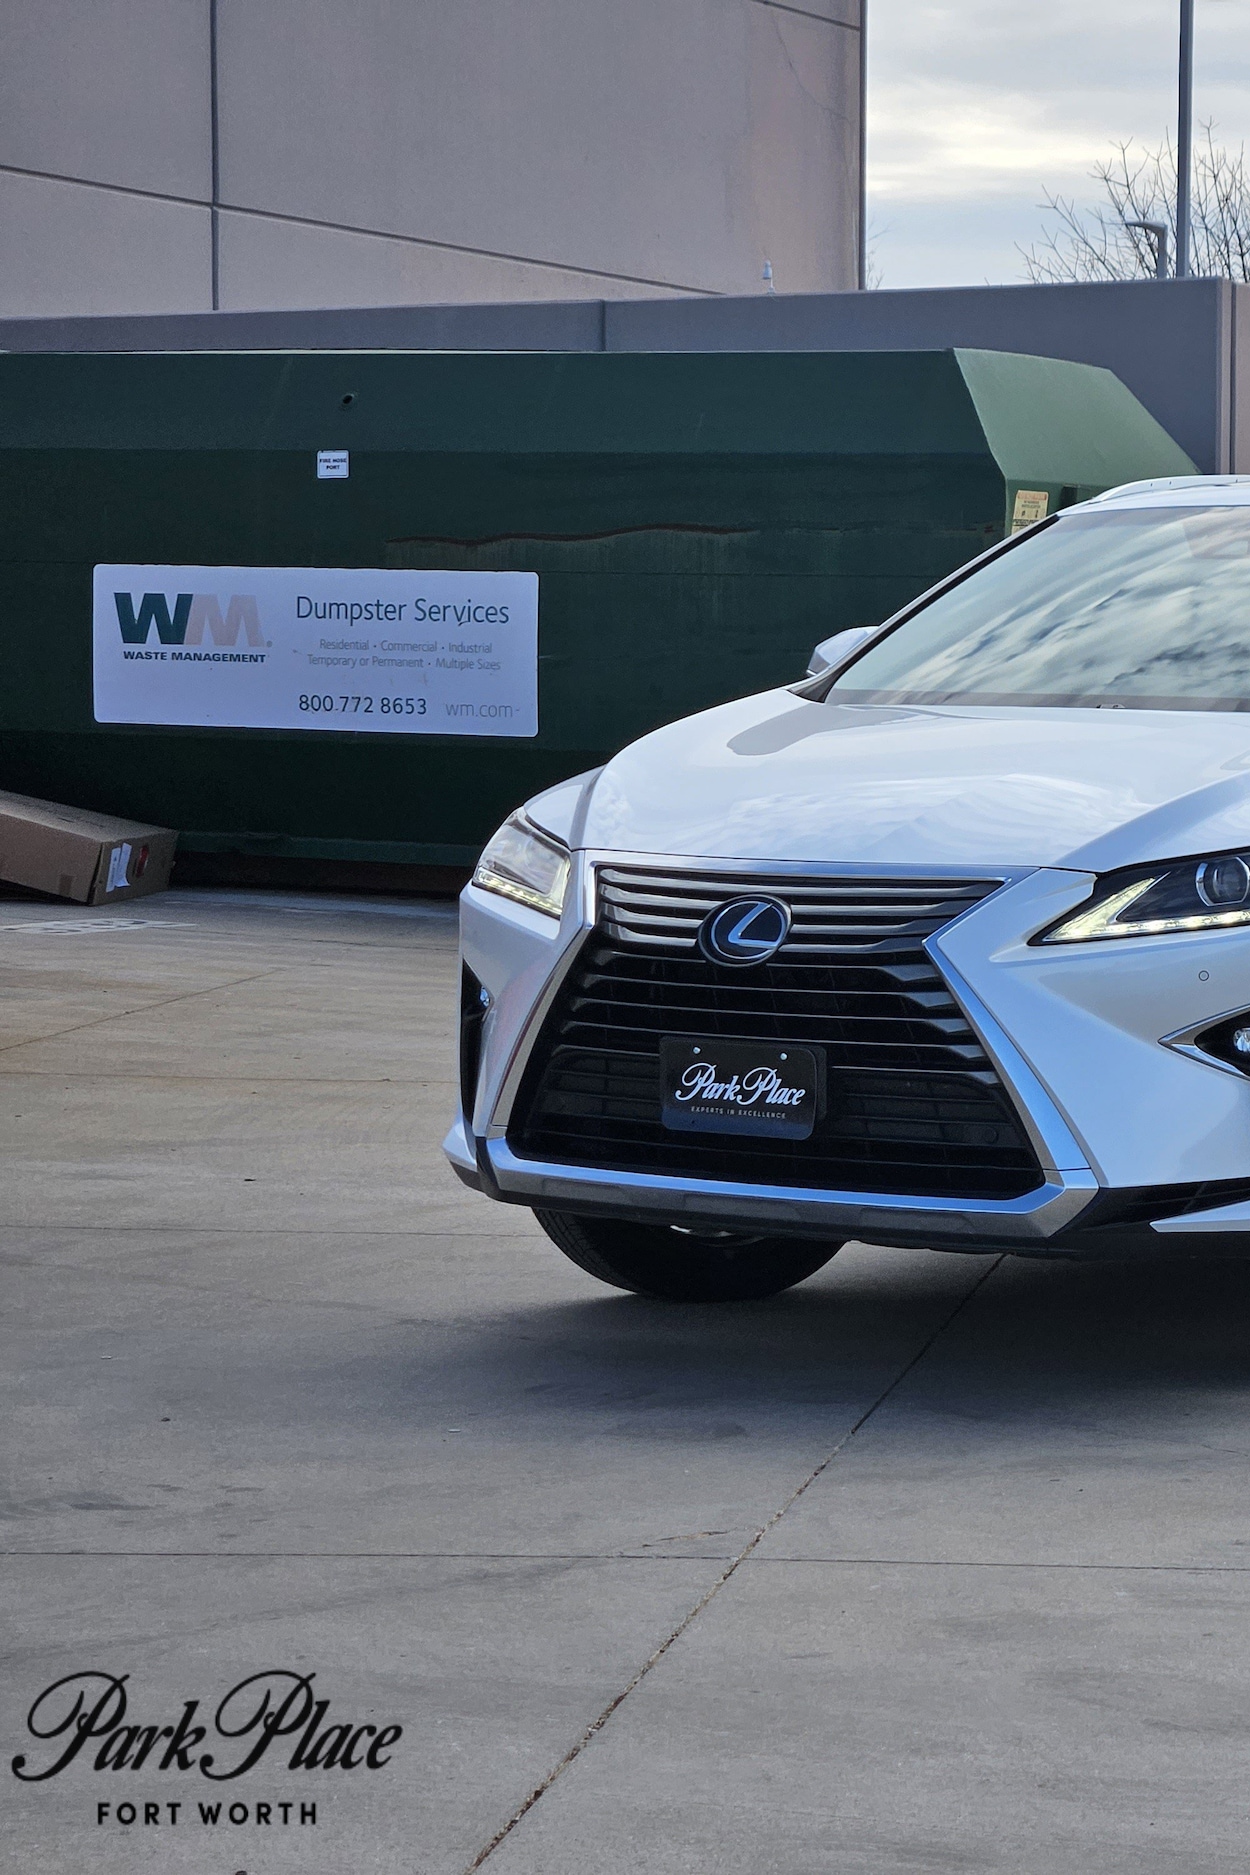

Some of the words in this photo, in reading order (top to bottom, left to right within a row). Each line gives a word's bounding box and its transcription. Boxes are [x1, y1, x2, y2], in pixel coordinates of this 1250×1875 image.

[114, 592, 265, 648] WM
[297, 596, 407, 627] Dumpster
[414, 598, 509, 624] Services
[320, 639, 370, 650] Residential
[380, 640, 438, 652] Commercial
[448, 642, 492, 653] Industrial
[123, 651, 168, 661] WASTE
[171, 652, 266, 663] MANAGEMENT
[307, 654, 357, 669] Temporary
[360, 659, 369, 667] or
[372, 655, 424, 668] Permanent
[435, 658, 475, 671] Multiple
[477, 659, 501, 671] Sizes
[380, 697, 427, 714] 8653
[445, 703, 513, 718] wm.com
[675, 1062, 740, 1101] Park
[736, 1067, 806, 1106] Place
[691, 1106, 724, 1114] EXPERTS
[738, 1110, 786, 1119] EXCELLENCE
